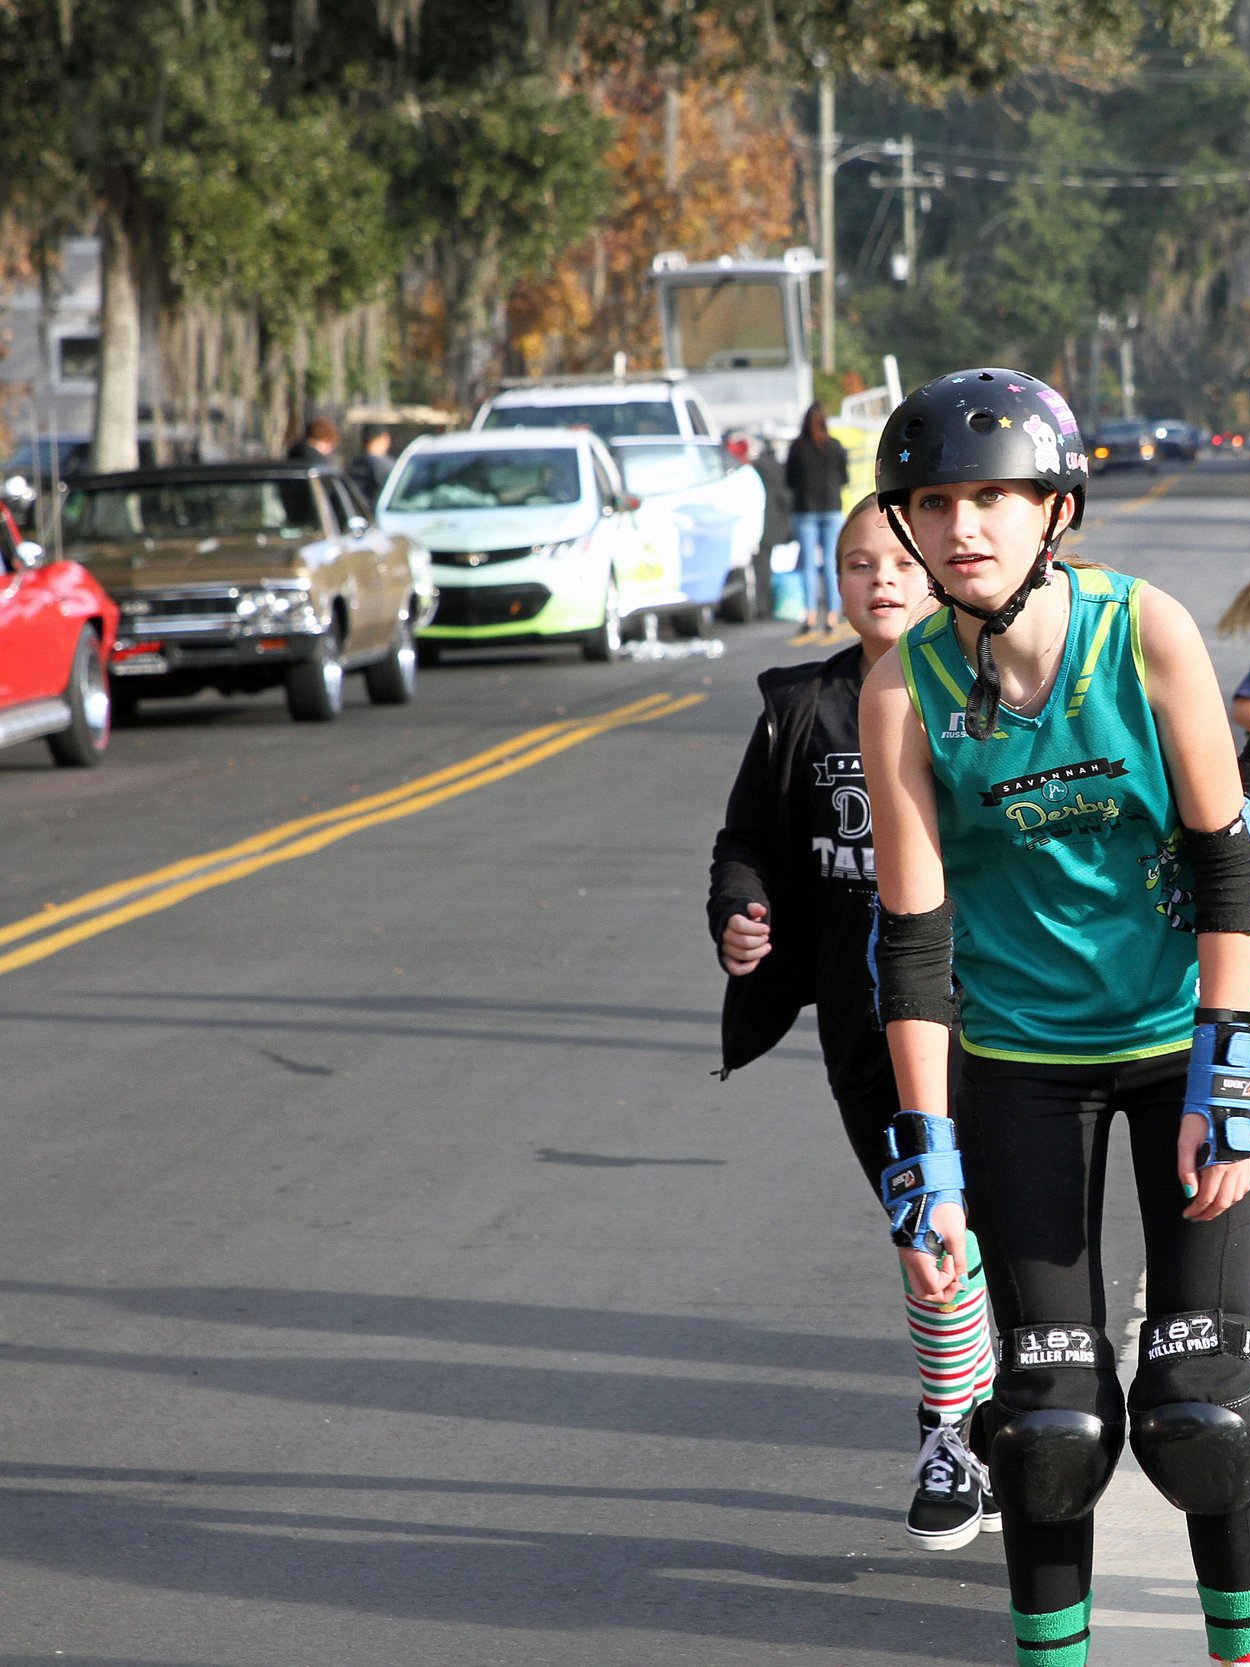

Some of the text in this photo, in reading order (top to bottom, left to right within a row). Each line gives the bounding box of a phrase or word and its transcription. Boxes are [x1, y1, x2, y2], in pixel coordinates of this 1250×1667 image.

[941, 731, 969, 739] RUSS
[1003, 764, 1099, 793] SAVANNAH
[1005, 793, 1120, 832] Derby
[812, 836, 877, 881] TAU
[1025, 1329, 1091, 1351] 187
[1152, 1318, 1213, 1346] 187
[1020, 1350, 1095, 1364] KILLER PADS
[1148, 1335, 1219, 1360] KILLER PADS
